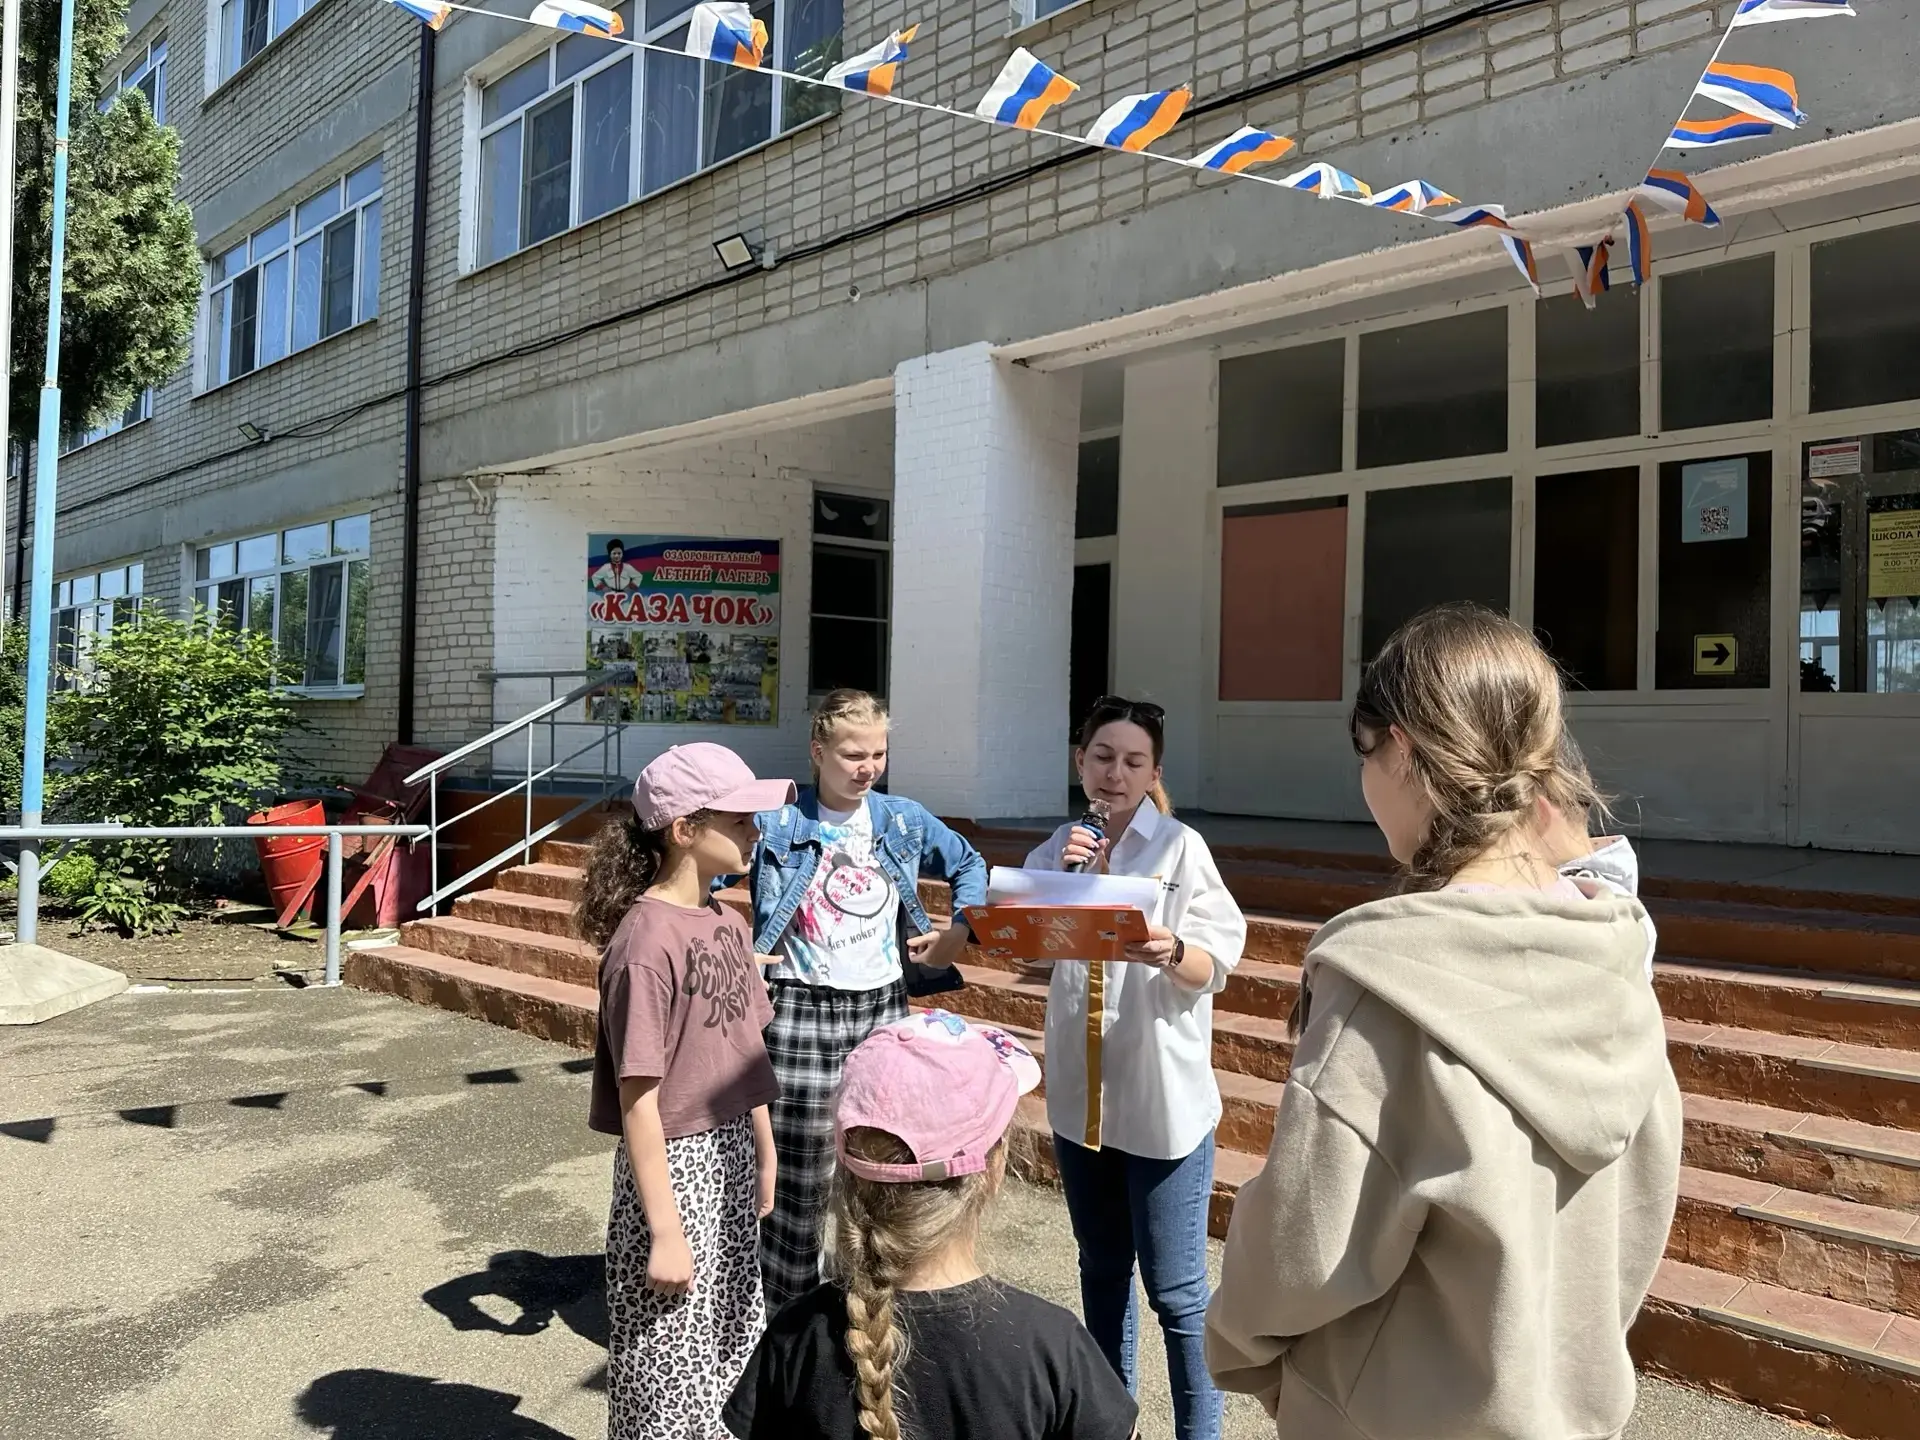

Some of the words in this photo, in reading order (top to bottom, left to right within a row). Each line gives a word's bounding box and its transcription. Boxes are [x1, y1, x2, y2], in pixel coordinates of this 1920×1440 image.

[1871, 530, 1914, 541] ШКОЛА
[663, 549, 762, 565] ОЗДОРОВИТЕЛЬНЫЙ
[653, 564, 712, 582] ЛЕТНИЙ
[716, 568, 771, 585] ЛАГЕРЬ
[691, 937, 708, 954] THE
[830, 938, 846, 951] HEY
[849, 926, 877, 945] HONEY
